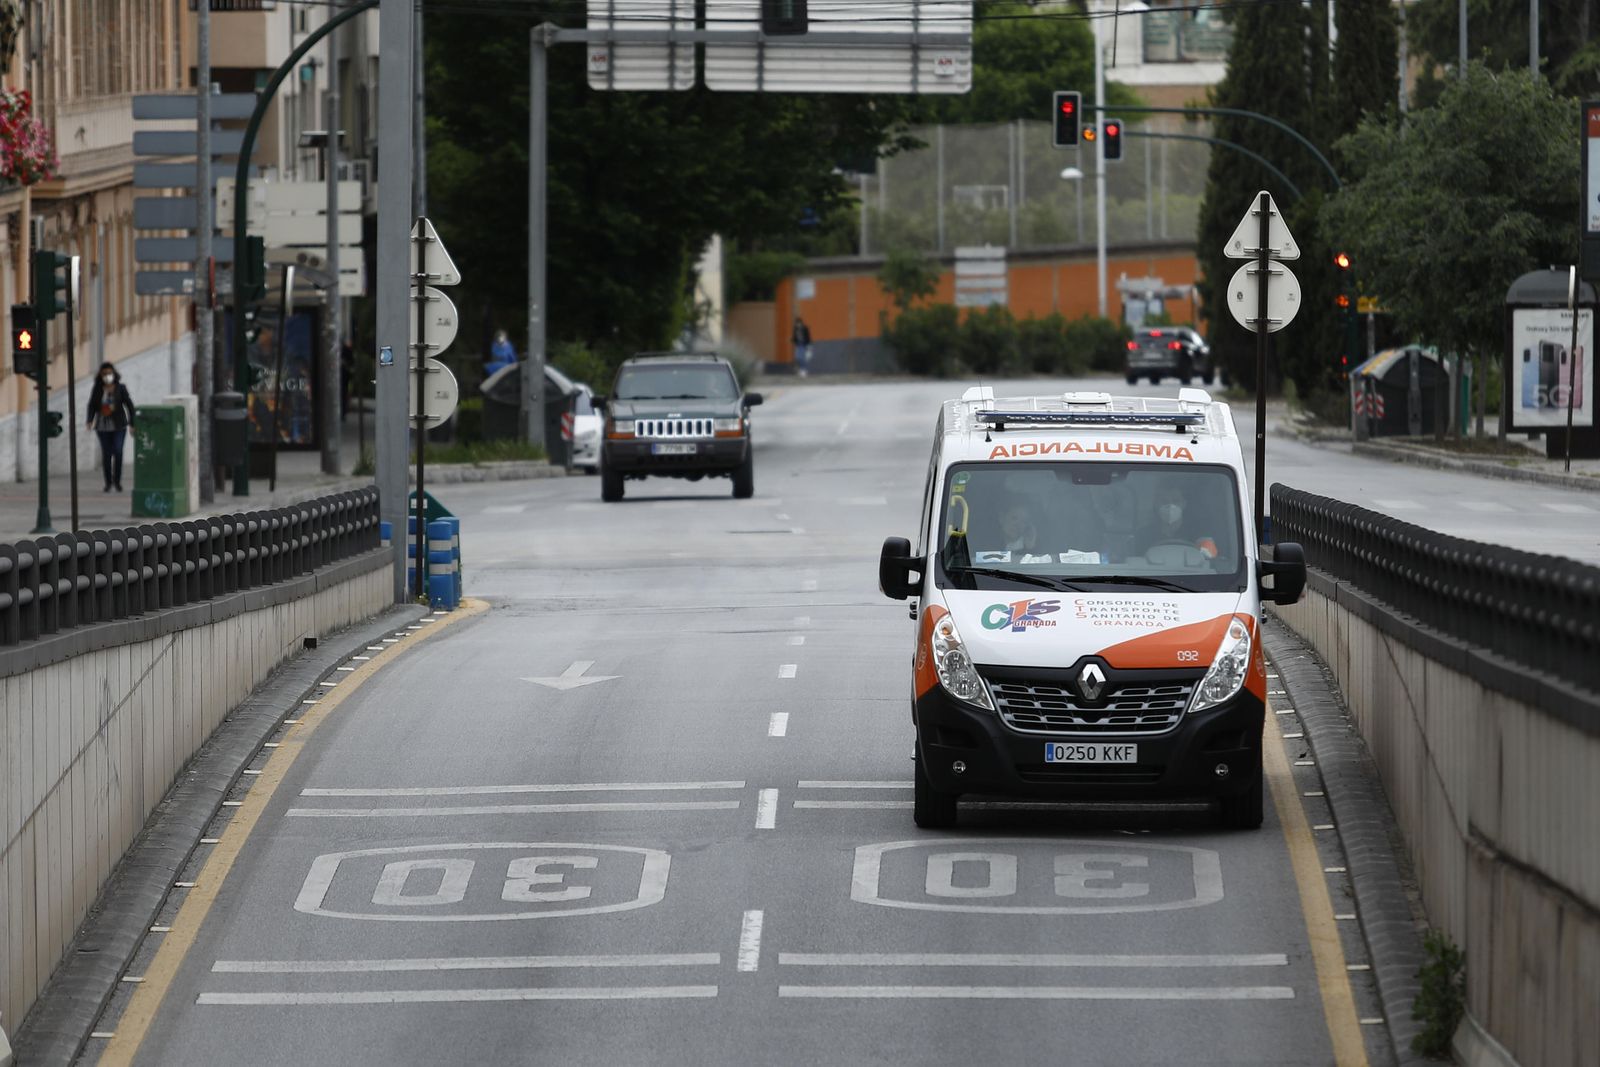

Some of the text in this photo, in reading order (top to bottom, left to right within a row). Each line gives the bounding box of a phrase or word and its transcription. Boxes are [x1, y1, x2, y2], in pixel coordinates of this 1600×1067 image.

[1075, 605, 1180, 614] TRANSPORTE
[1093, 620, 1165, 628] GRANADA
[1177, 650, 1199, 661] 092
[1055, 746, 1134, 761] 0250 KKF
